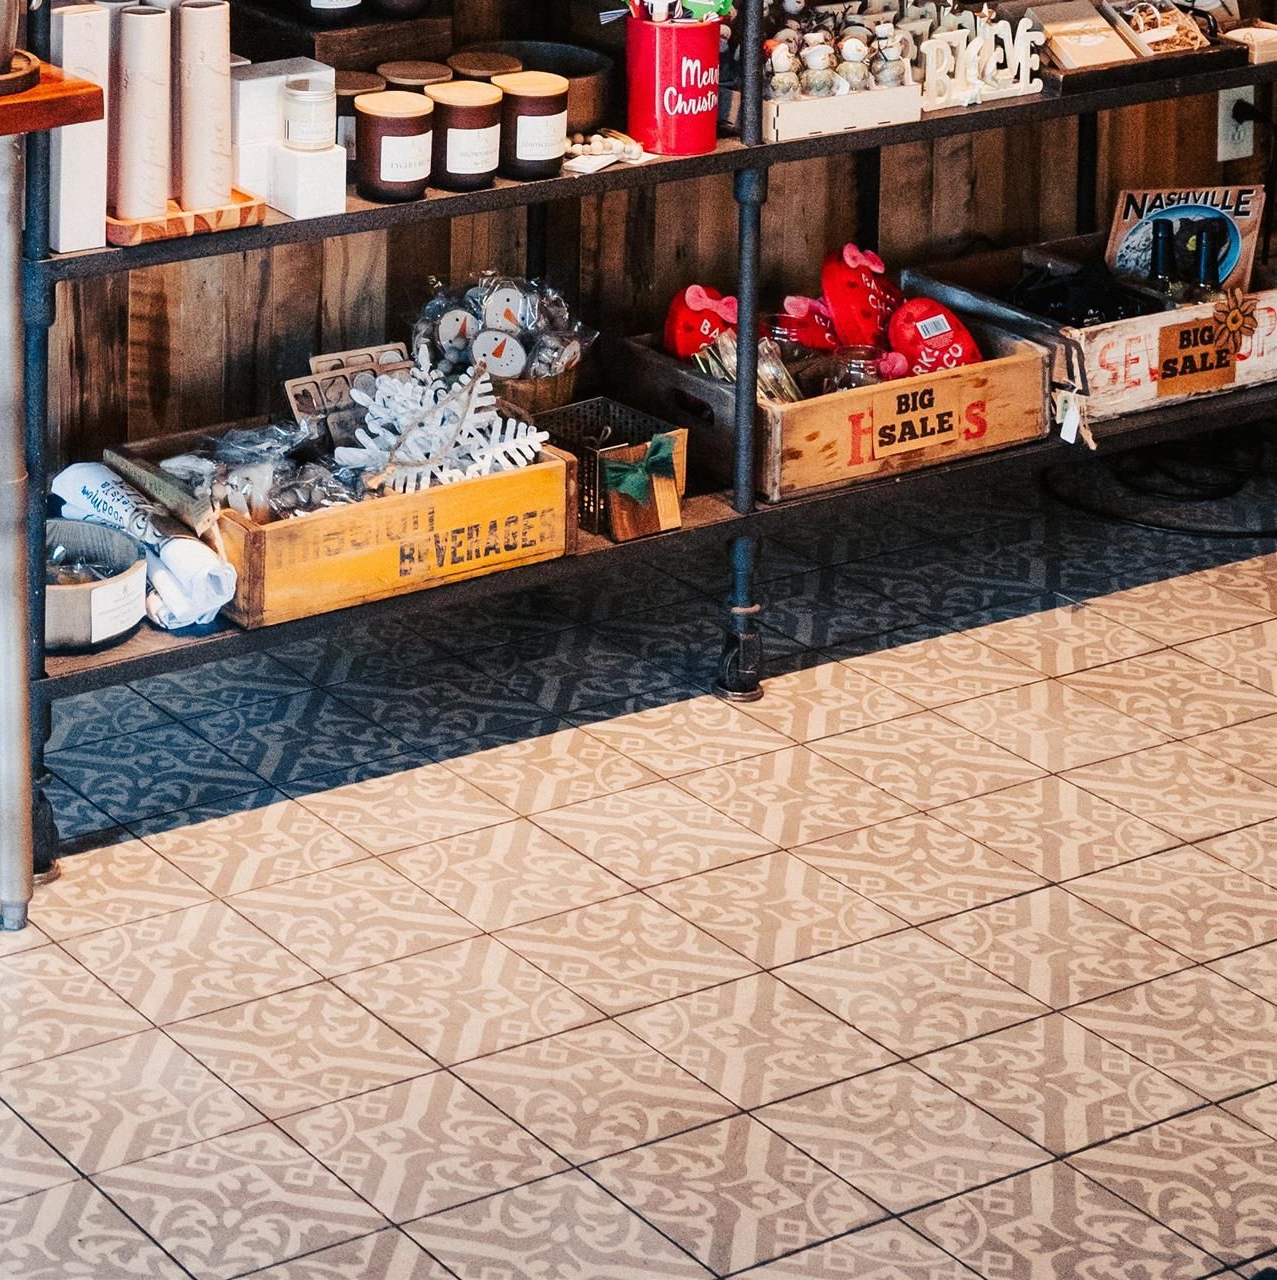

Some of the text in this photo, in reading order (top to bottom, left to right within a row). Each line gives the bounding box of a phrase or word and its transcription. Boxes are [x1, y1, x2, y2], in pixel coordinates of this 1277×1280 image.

[664, 86, 719, 115] Christ
[1123, 189, 1257, 222] NASHVILLE
[1178, 325, 1215, 350] BIG
[1161, 349, 1231, 380] SALE
[895, 388, 935, 415] BIG
[878, 411, 954, 447] SALE
